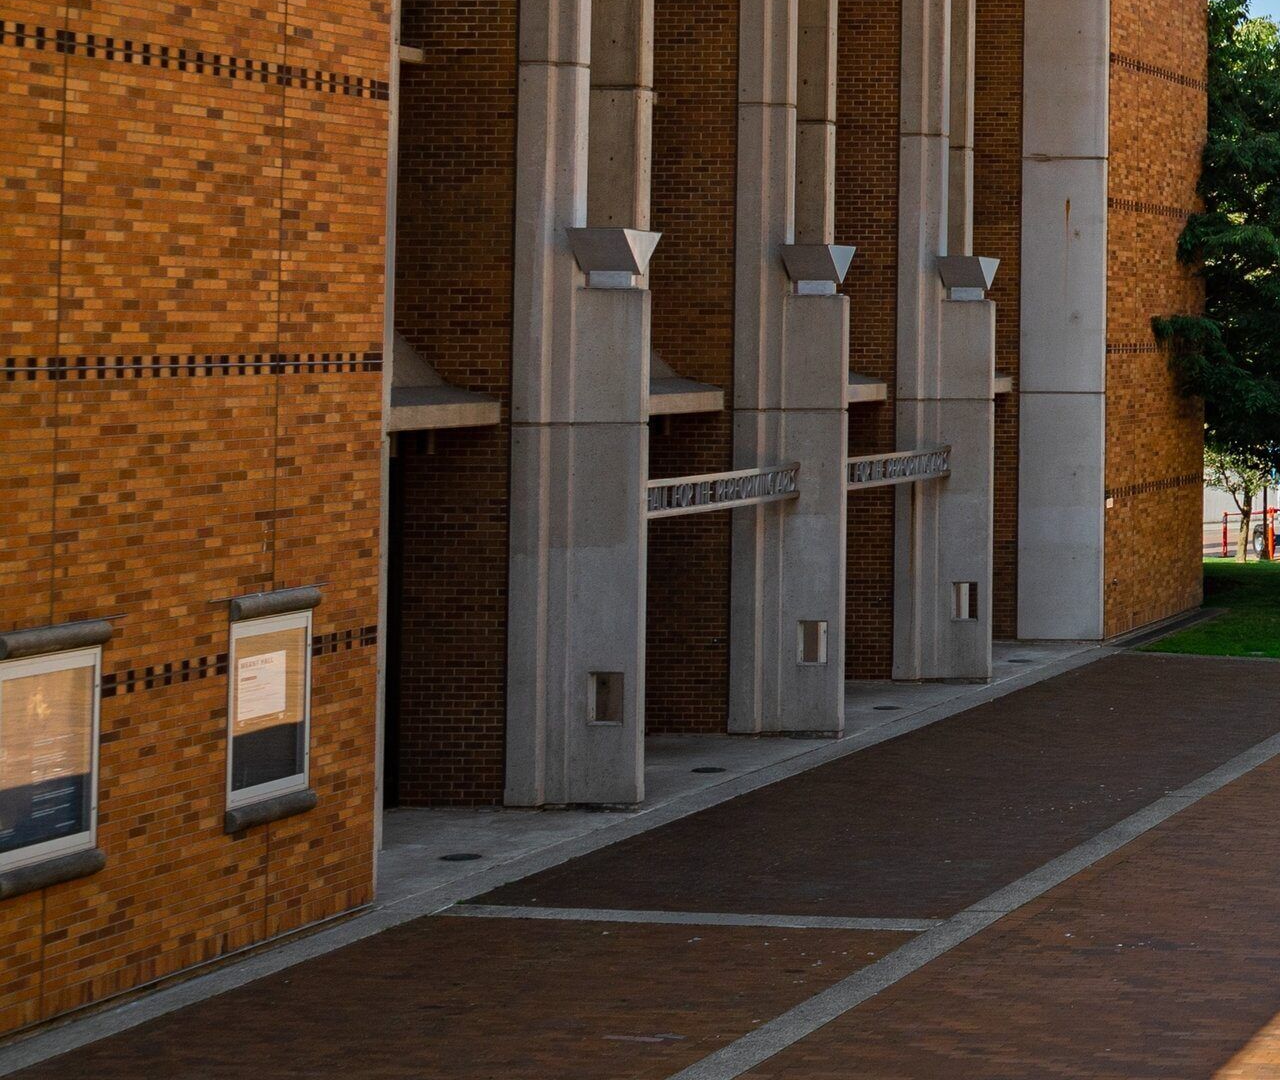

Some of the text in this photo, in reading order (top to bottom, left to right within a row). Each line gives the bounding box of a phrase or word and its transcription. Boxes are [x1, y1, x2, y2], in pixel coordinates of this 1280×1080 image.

[672, 483, 694, 508] FOR
[694, 480, 714, 505] THE
[715, 472, 774, 502] PERFORMING
[776, 470, 796, 493] ARTS
